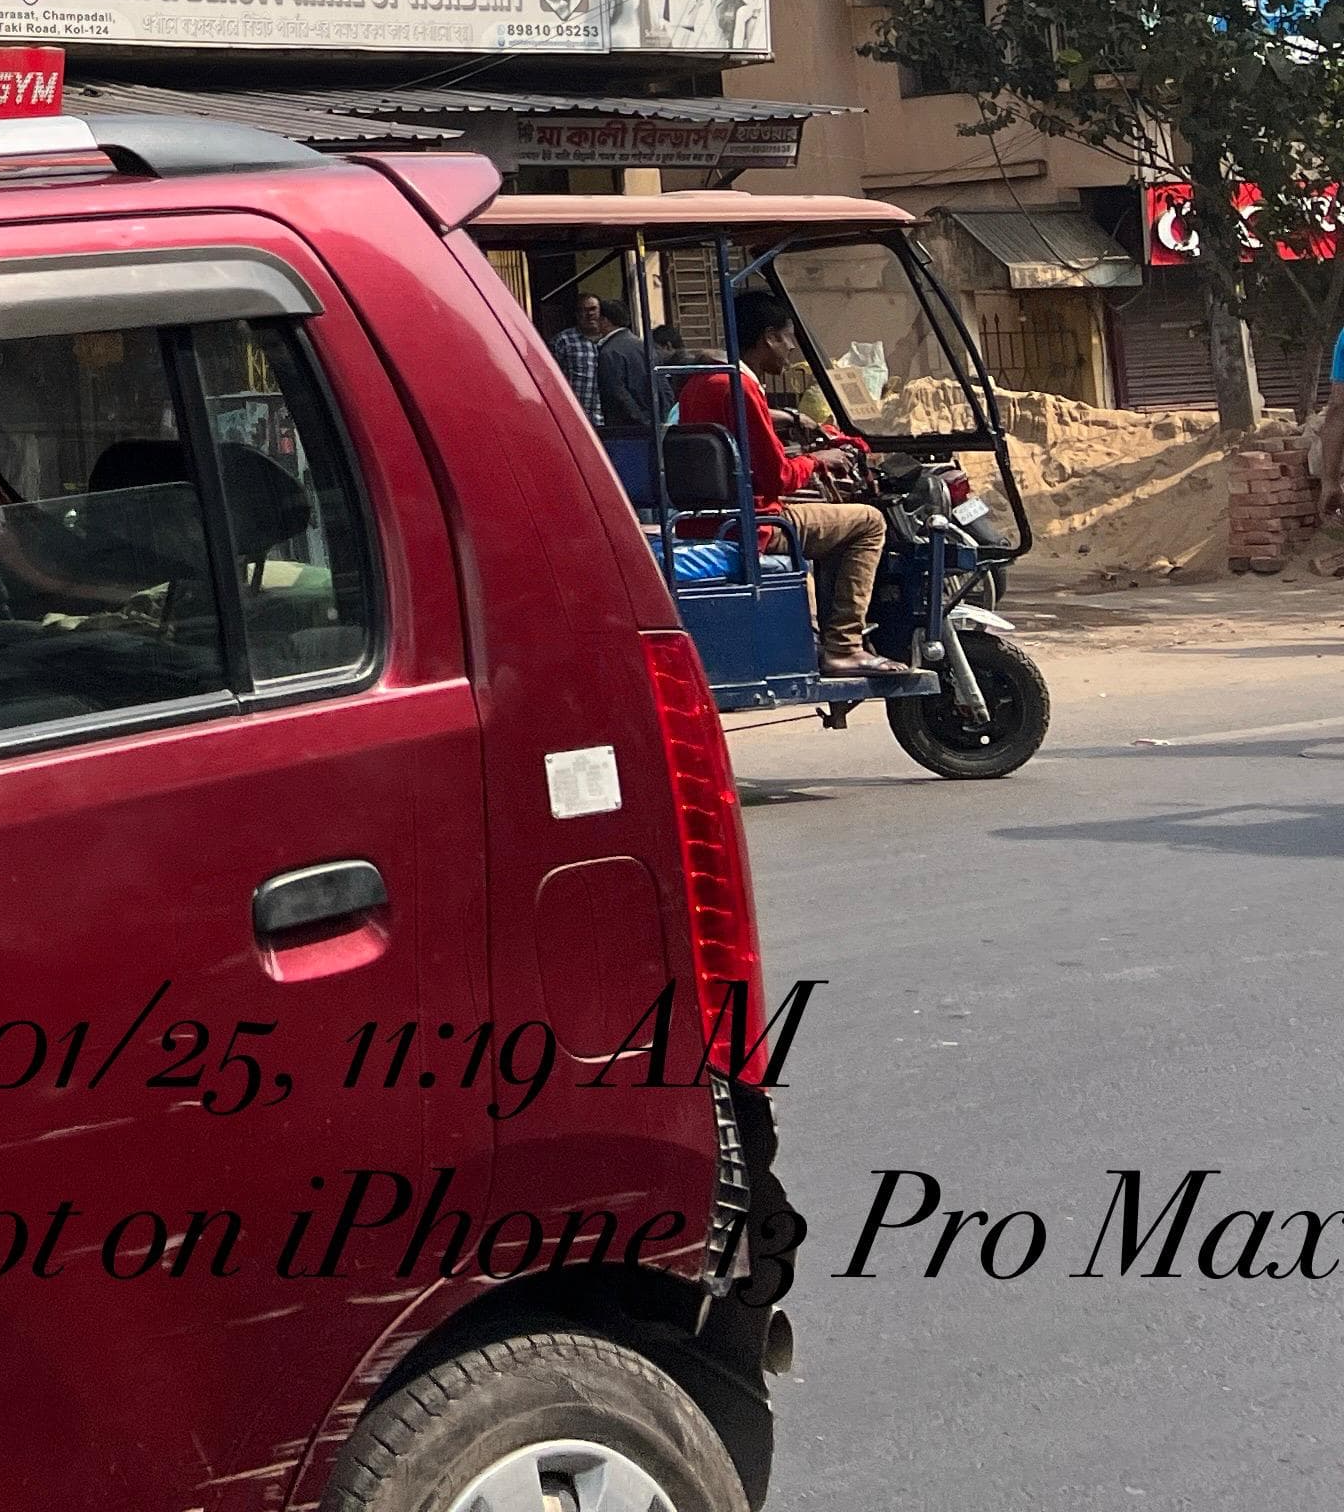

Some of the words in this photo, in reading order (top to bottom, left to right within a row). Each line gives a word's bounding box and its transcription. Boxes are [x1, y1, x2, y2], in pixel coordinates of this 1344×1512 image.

[26, 23, 61, 35] Road,
[64, 23, 109, 35] Kol-124
[507, 24, 551, 36] 89810
[556, 25, 599, 37] 05253
